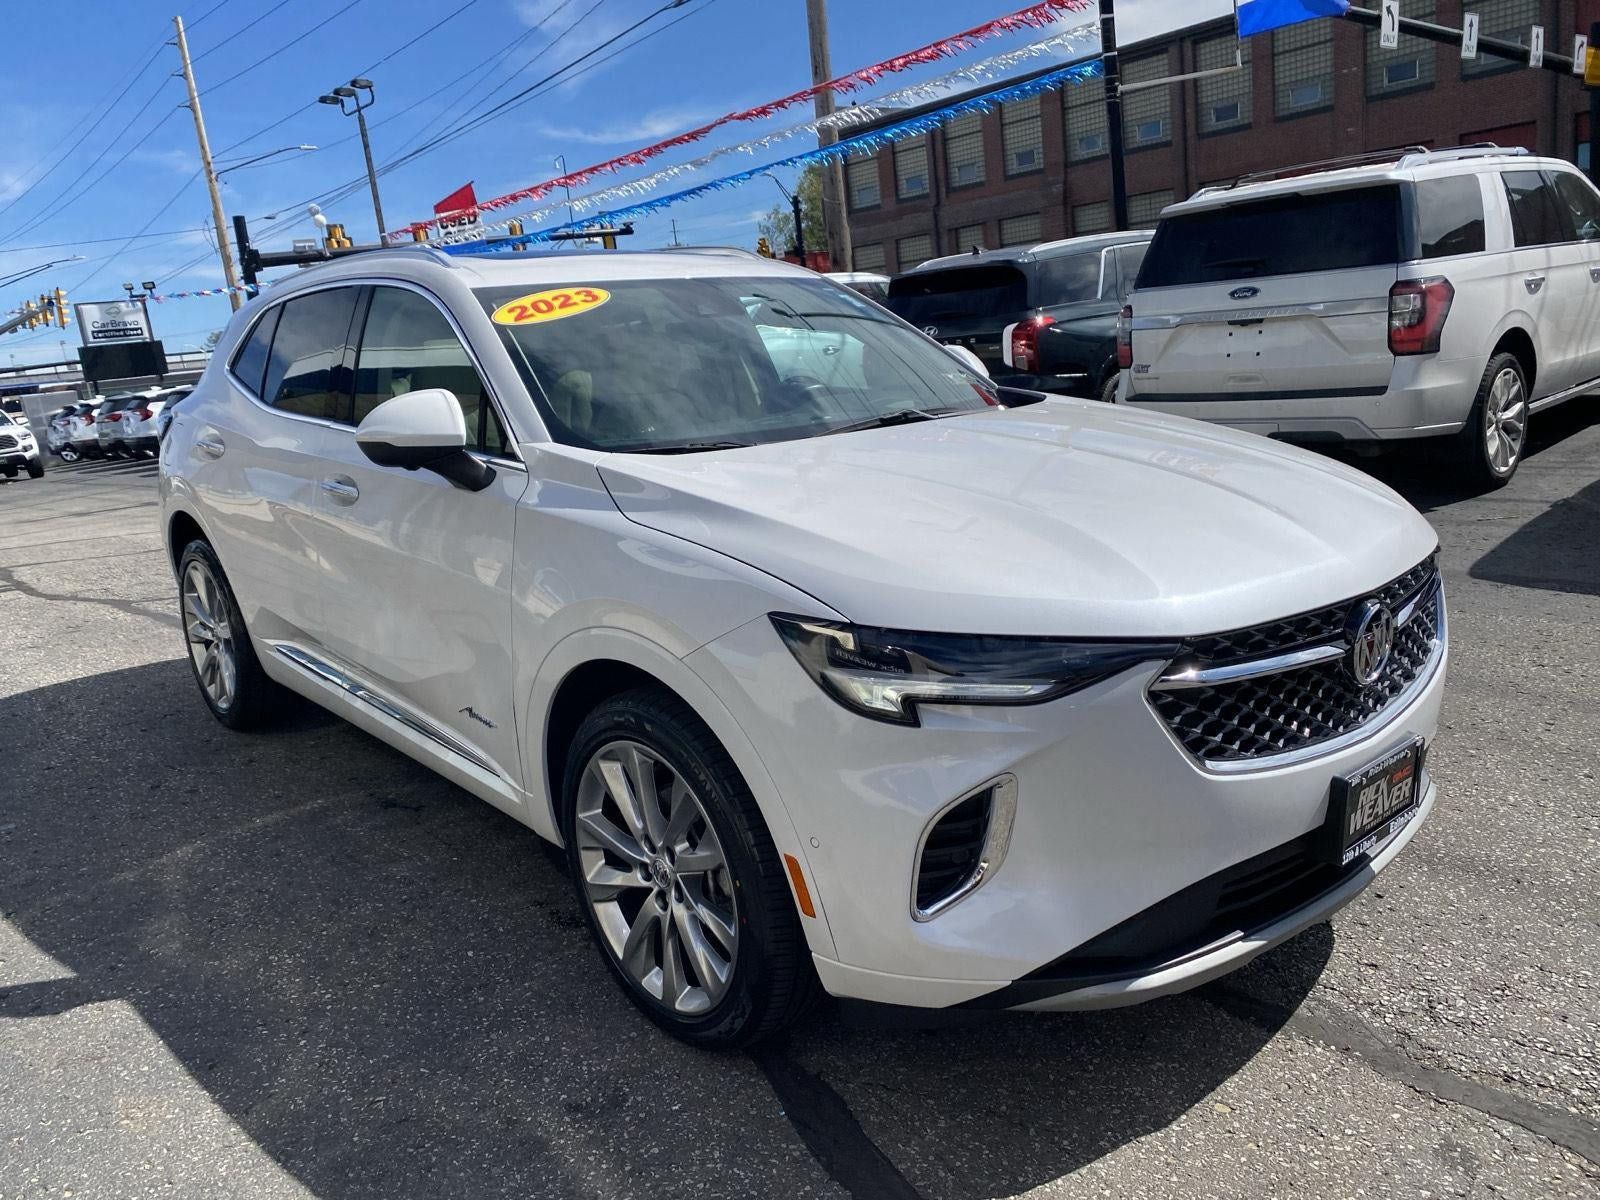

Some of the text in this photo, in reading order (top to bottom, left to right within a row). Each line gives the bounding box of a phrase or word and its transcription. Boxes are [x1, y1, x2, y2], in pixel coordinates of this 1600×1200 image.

[507, 289, 599, 322] 2023
[91, 319, 139, 329] CarBravo
[93, 330, 124, 338] Certified
[1349, 777, 1413, 836] WEAVER
[1358, 775, 1391, 809] RICK
